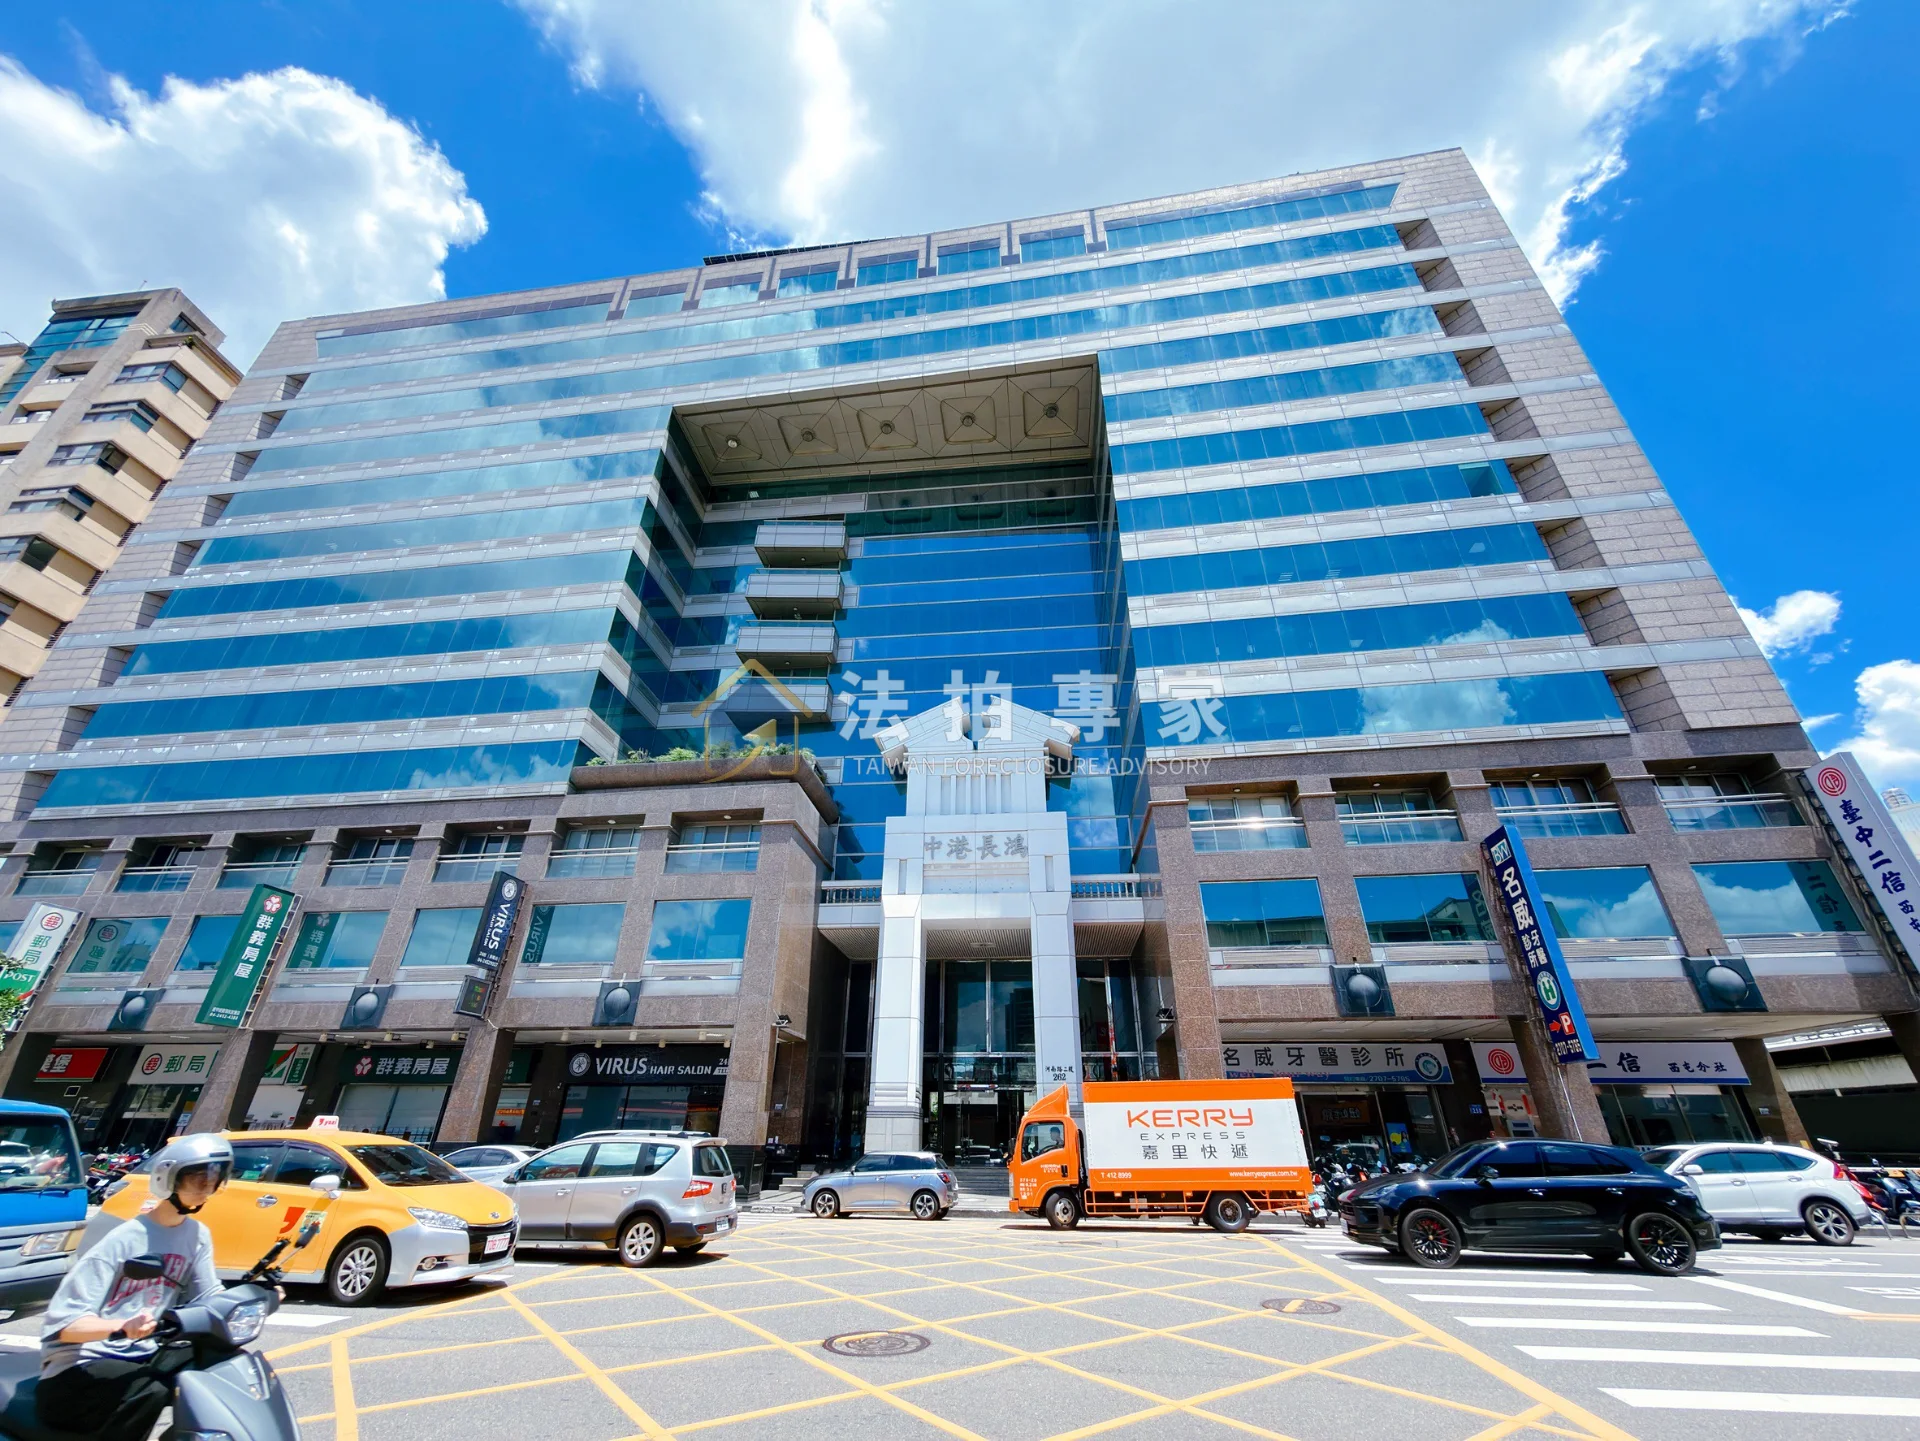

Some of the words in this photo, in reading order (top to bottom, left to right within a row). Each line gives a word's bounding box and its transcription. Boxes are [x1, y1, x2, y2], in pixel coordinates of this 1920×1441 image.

[924, 834, 1028, 860] 中港長鴻
[1839, 799, 1906, 894] 臺中二信
[1502, 866, 1534, 930] 名威
[489, 903, 511, 950] VIRUS
[23, 934, 52, 965] 郵局
[234, 914, 274, 979] 群義房屋
[4, 971, 35, 983] POST
[163, 1055, 207, 1073] 郵局
[375, 1057, 450, 1075] 群義房屋
[595, 1057, 648, 1075] VIRUS
[650, 1065, 675, 1075] HAIR
[677, 1065, 712, 1075] SALON
[1223, 1046, 1405, 1067] 名威牙醫診所
[1668, 1061, 1728, 1073] 西屯分社
[1053, 1073, 1067, 1081] 262
[1127, 1108, 1254, 1128] KERRY
[1140, 1131, 1246, 1141] EXPRESS
[1141, 1143, 1248, 1160] 嘉里快遞
